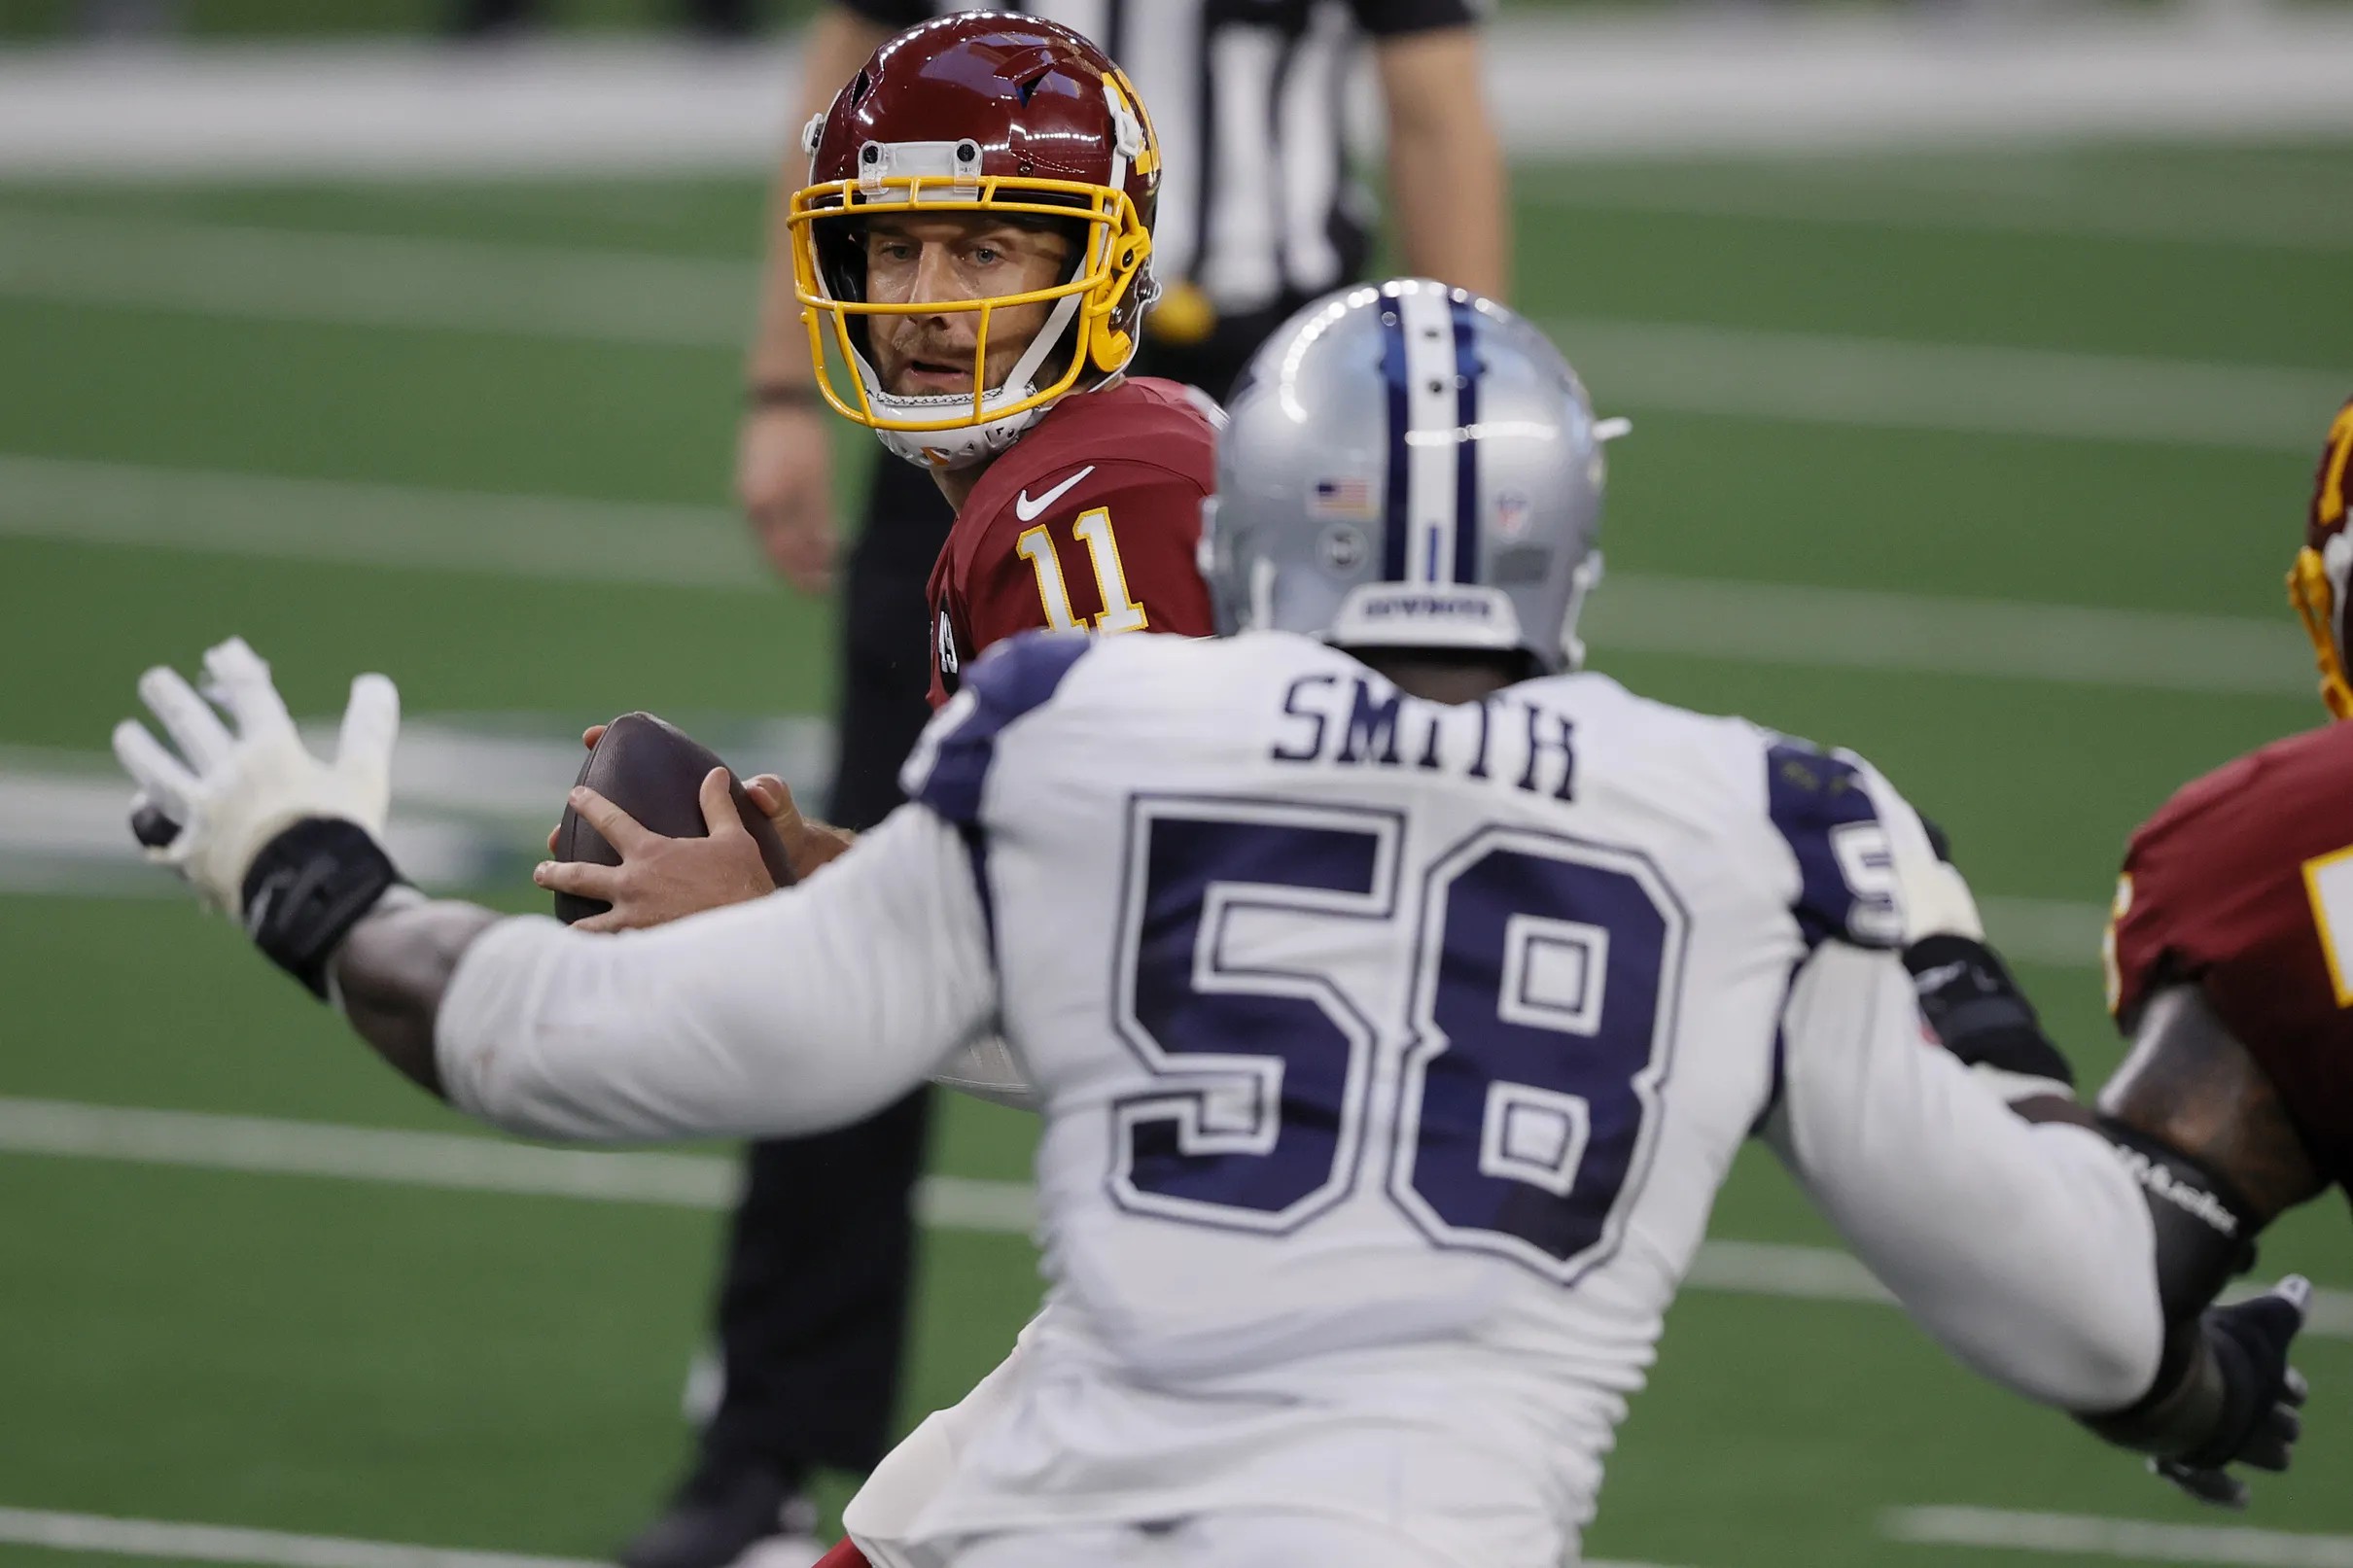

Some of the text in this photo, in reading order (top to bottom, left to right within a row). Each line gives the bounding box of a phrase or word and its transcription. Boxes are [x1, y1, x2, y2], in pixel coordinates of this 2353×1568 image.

[1016, 506, 1149, 637] 11
[1271, 674, 1576, 802] SMITH
[1103, 791, 1692, 1288] 58
